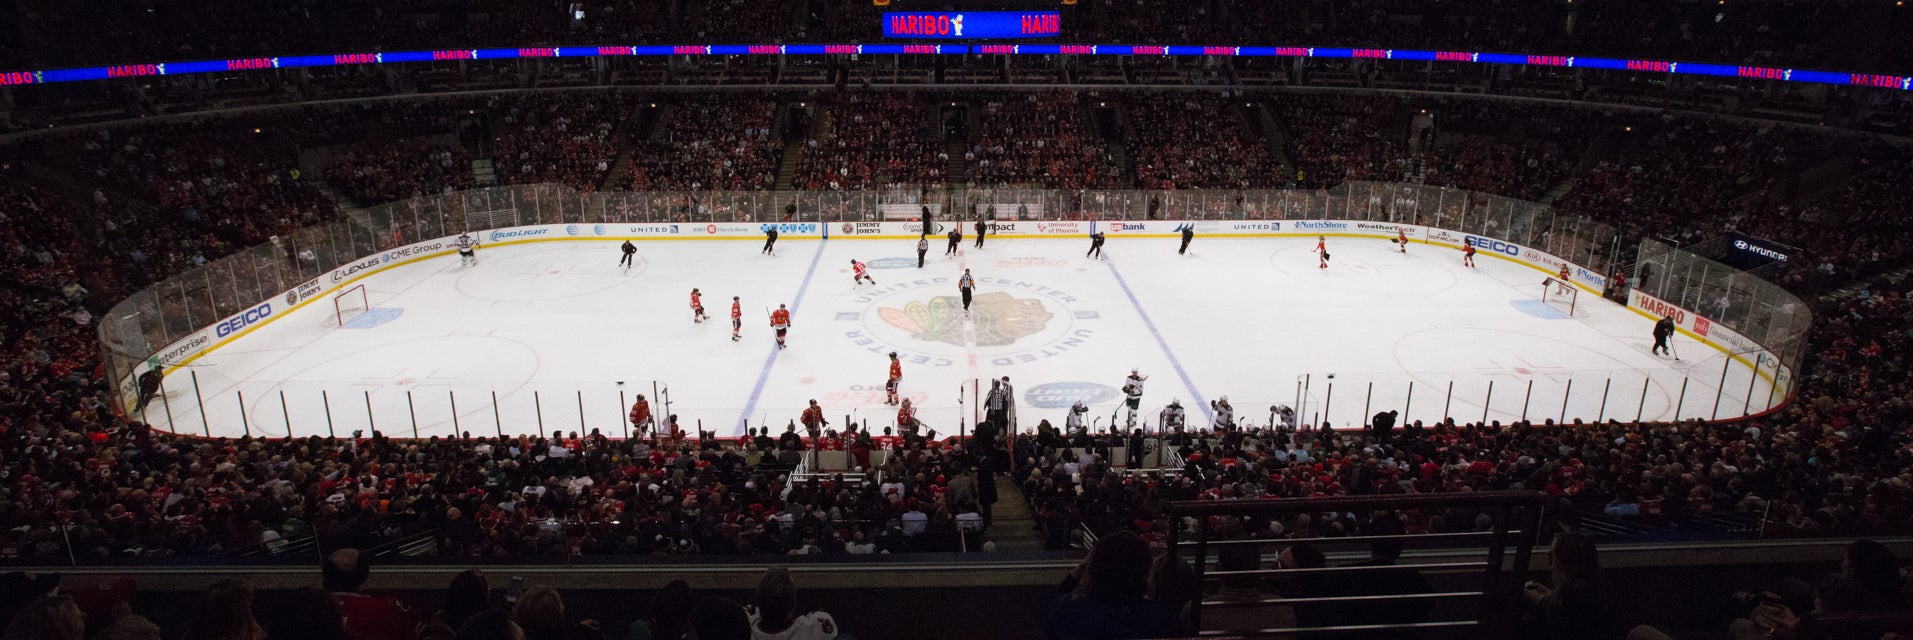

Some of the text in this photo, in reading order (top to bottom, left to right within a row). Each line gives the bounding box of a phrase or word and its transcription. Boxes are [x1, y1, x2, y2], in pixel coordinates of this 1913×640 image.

[891, 14, 1061, 35] HARIBO HARIB
[433, 49, 471, 60] HARIBO
[519, 48, 555, 57] HARIBO
[597, 46, 632, 55] HARIBO
[673, 45, 707, 54] HARIBO
[748, 45, 781, 54] HARIBO
[824, 44, 858, 54] HARIBO
[903, 45, 935, 54] HARIBO
[981, 45, 1014, 54] HARIBO
[1059, 45, 1092, 54] HARIBO
[1132, 46, 1165, 54] HARIBO
[1203, 46, 1235, 55] HARIBO
[1275, 48, 1309, 57] HARIBO
[1353, 49, 1387, 58] HARIBO
[335, 54, 375, 64] HARIBO
[1436, 51, 1473, 61] HARIBO
[1527, 55, 1567, 66] HARIBO
[228, 58, 271, 69] HARIBO
[1626, 61, 1669, 72] HARIBO
[108, 63, 157, 77] HARIBO
[1737, 66, 1783, 79] HARIBO
[1851, 73, 1902, 89] HARIBO
[1300, 221, 1348, 229] NorthShore
[517, 228, 548, 236] LIGHT
[390, 249, 412, 260] CME
[413, 242, 442, 255] Group
[1465, 235, 1519, 256] GEICO
[1749, 244, 1788, 262] HYUNDAI
[341, 257, 380, 276] LEXUS
[298, 279, 320, 293] JIMMY
[853, 276, 1078, 304] UNITED CENTER
[1640, 295, 1685, 325] HARIBO
[216, 303, 272, 338] GEICO
[992, 328, 1094, 368] UNITED
